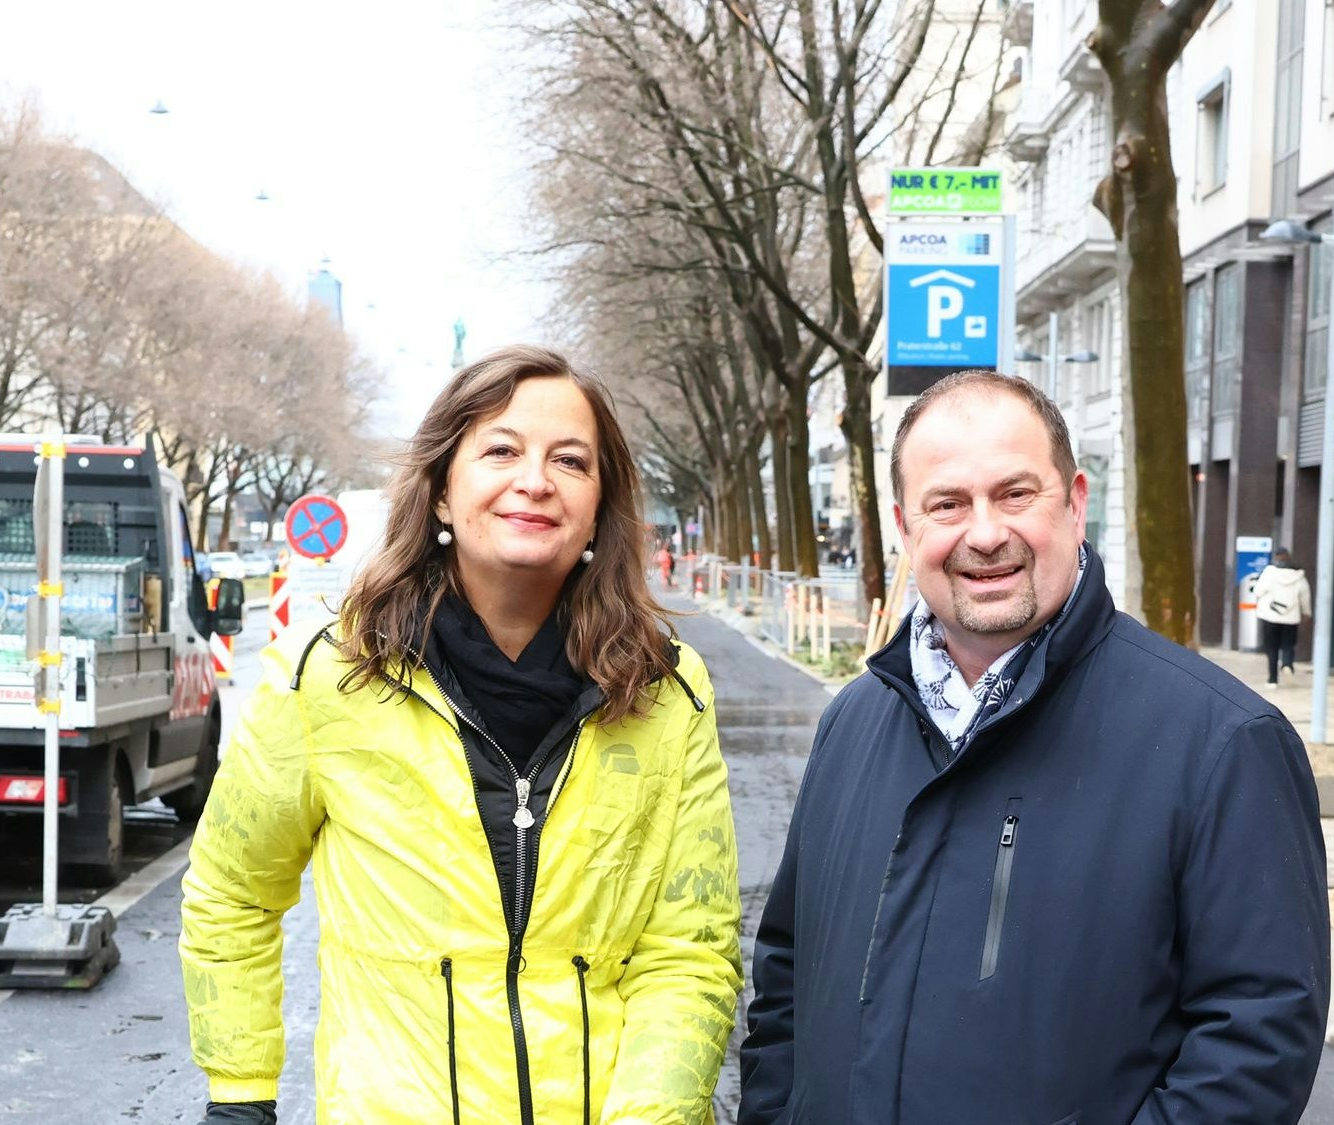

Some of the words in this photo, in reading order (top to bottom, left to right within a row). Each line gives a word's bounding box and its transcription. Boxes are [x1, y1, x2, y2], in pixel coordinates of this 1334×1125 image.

[891, 175, 924, 189] NUR
[971, 175, 1000, 189] MIT
[900, 234, 947, 245] APCOA
[927, 285, 964, 339] P
